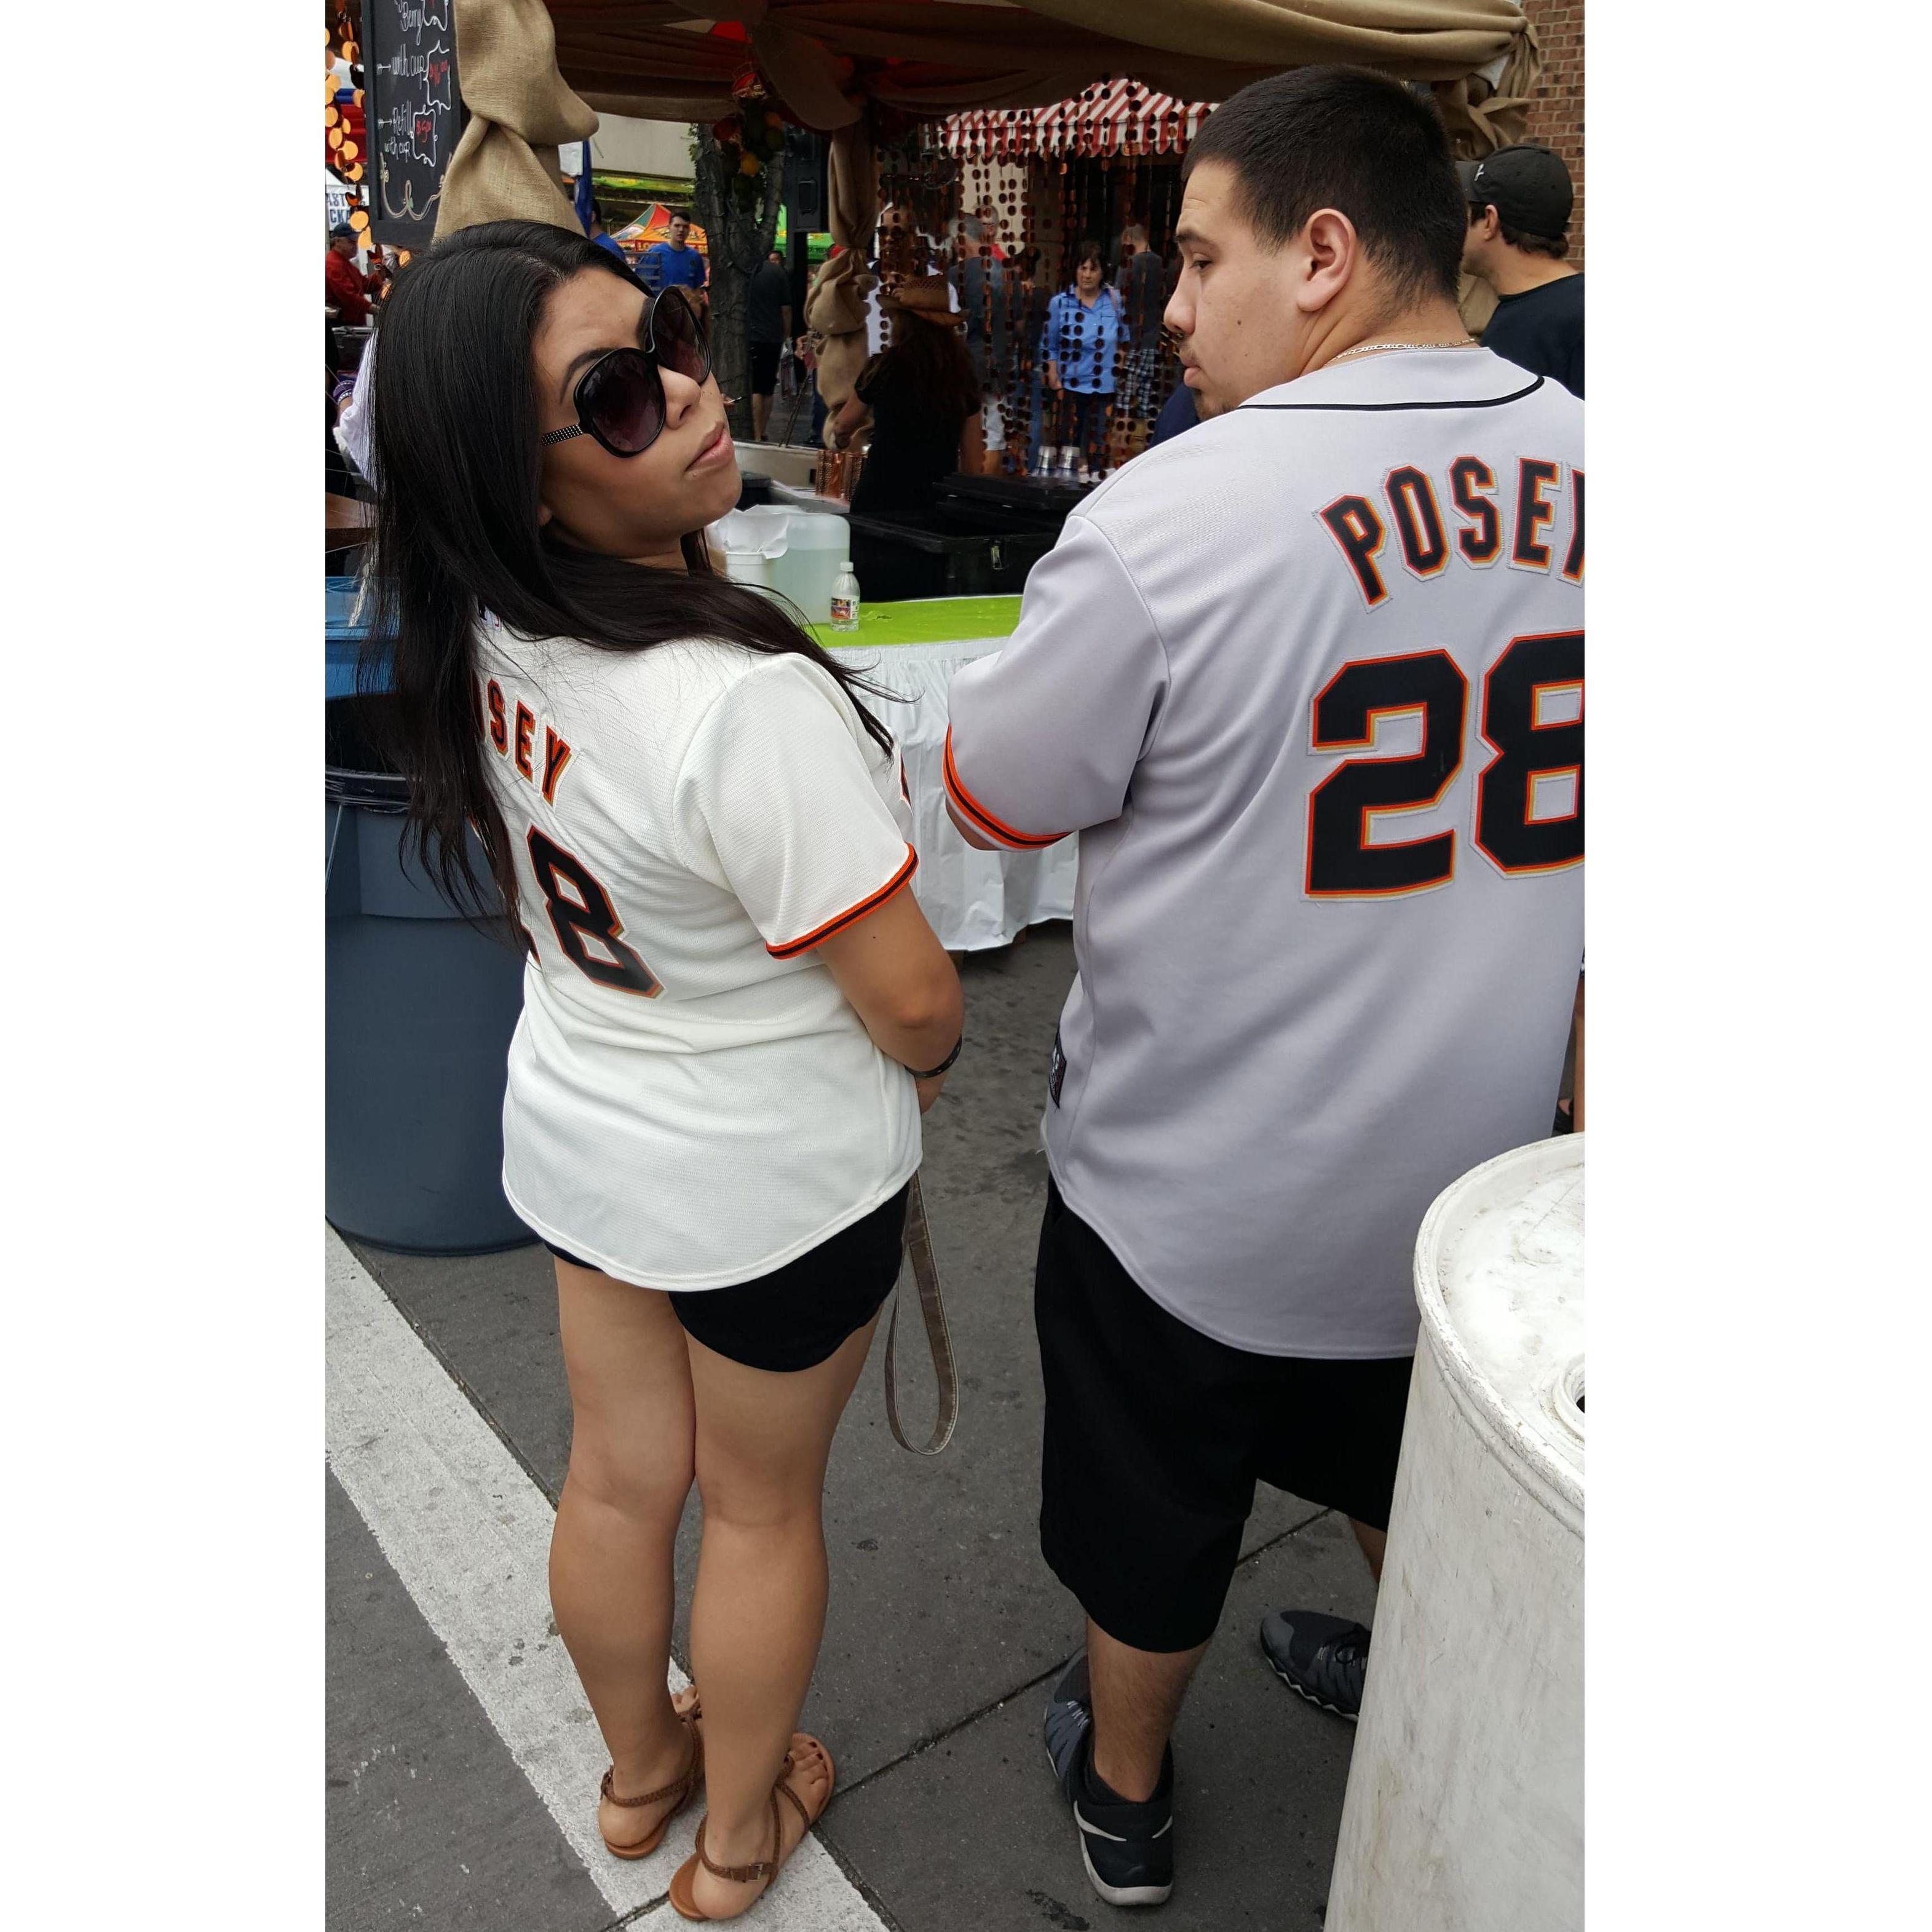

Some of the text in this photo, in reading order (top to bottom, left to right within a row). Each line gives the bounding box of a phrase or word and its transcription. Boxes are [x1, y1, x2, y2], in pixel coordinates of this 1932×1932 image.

[392, 44, 410, 77] with
[410, 55, 425, 90] cup
[384, 137, 399, 160] with
[392, 100, 412, 136] Refill
[473, 669, 572, 807] SEY
[1305, 629, 1585, 895] 28
[523, 823, 666, 999] 8
